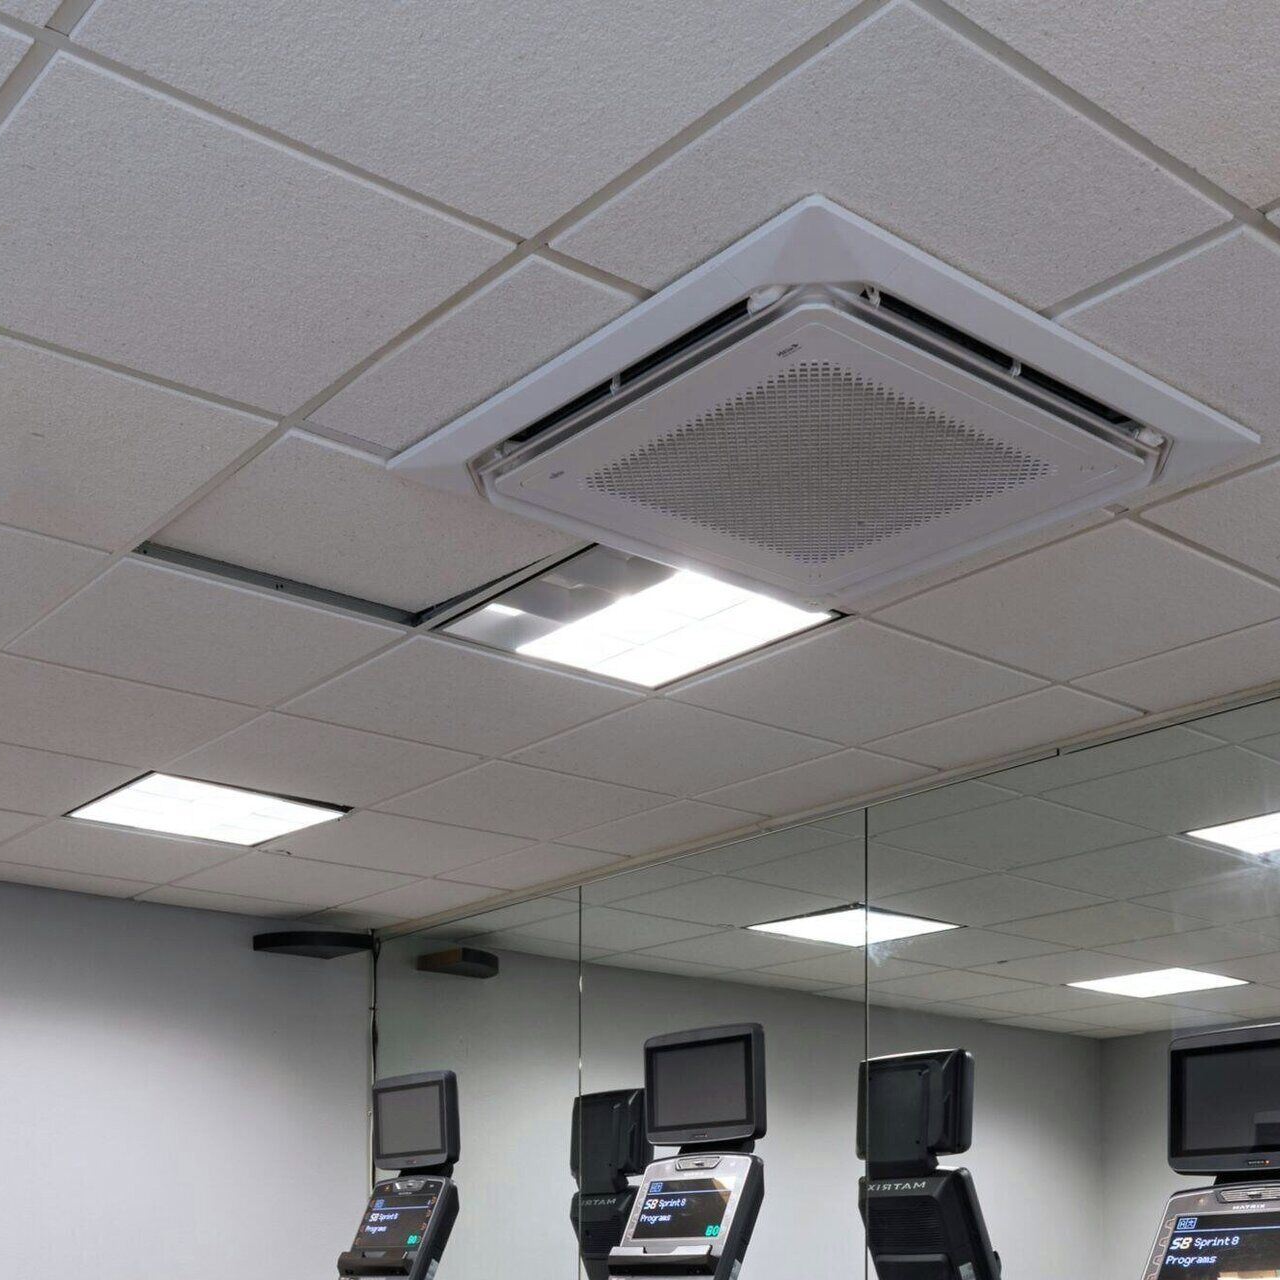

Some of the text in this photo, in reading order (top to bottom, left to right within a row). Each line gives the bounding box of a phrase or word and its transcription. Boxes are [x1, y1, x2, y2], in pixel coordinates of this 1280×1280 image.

[658, 1199, 681, 1210] Sprint
[1169, 1236, 1241, 1250] S8 Sprint 8
[1165, 1254, 1218, 1267] Programs
